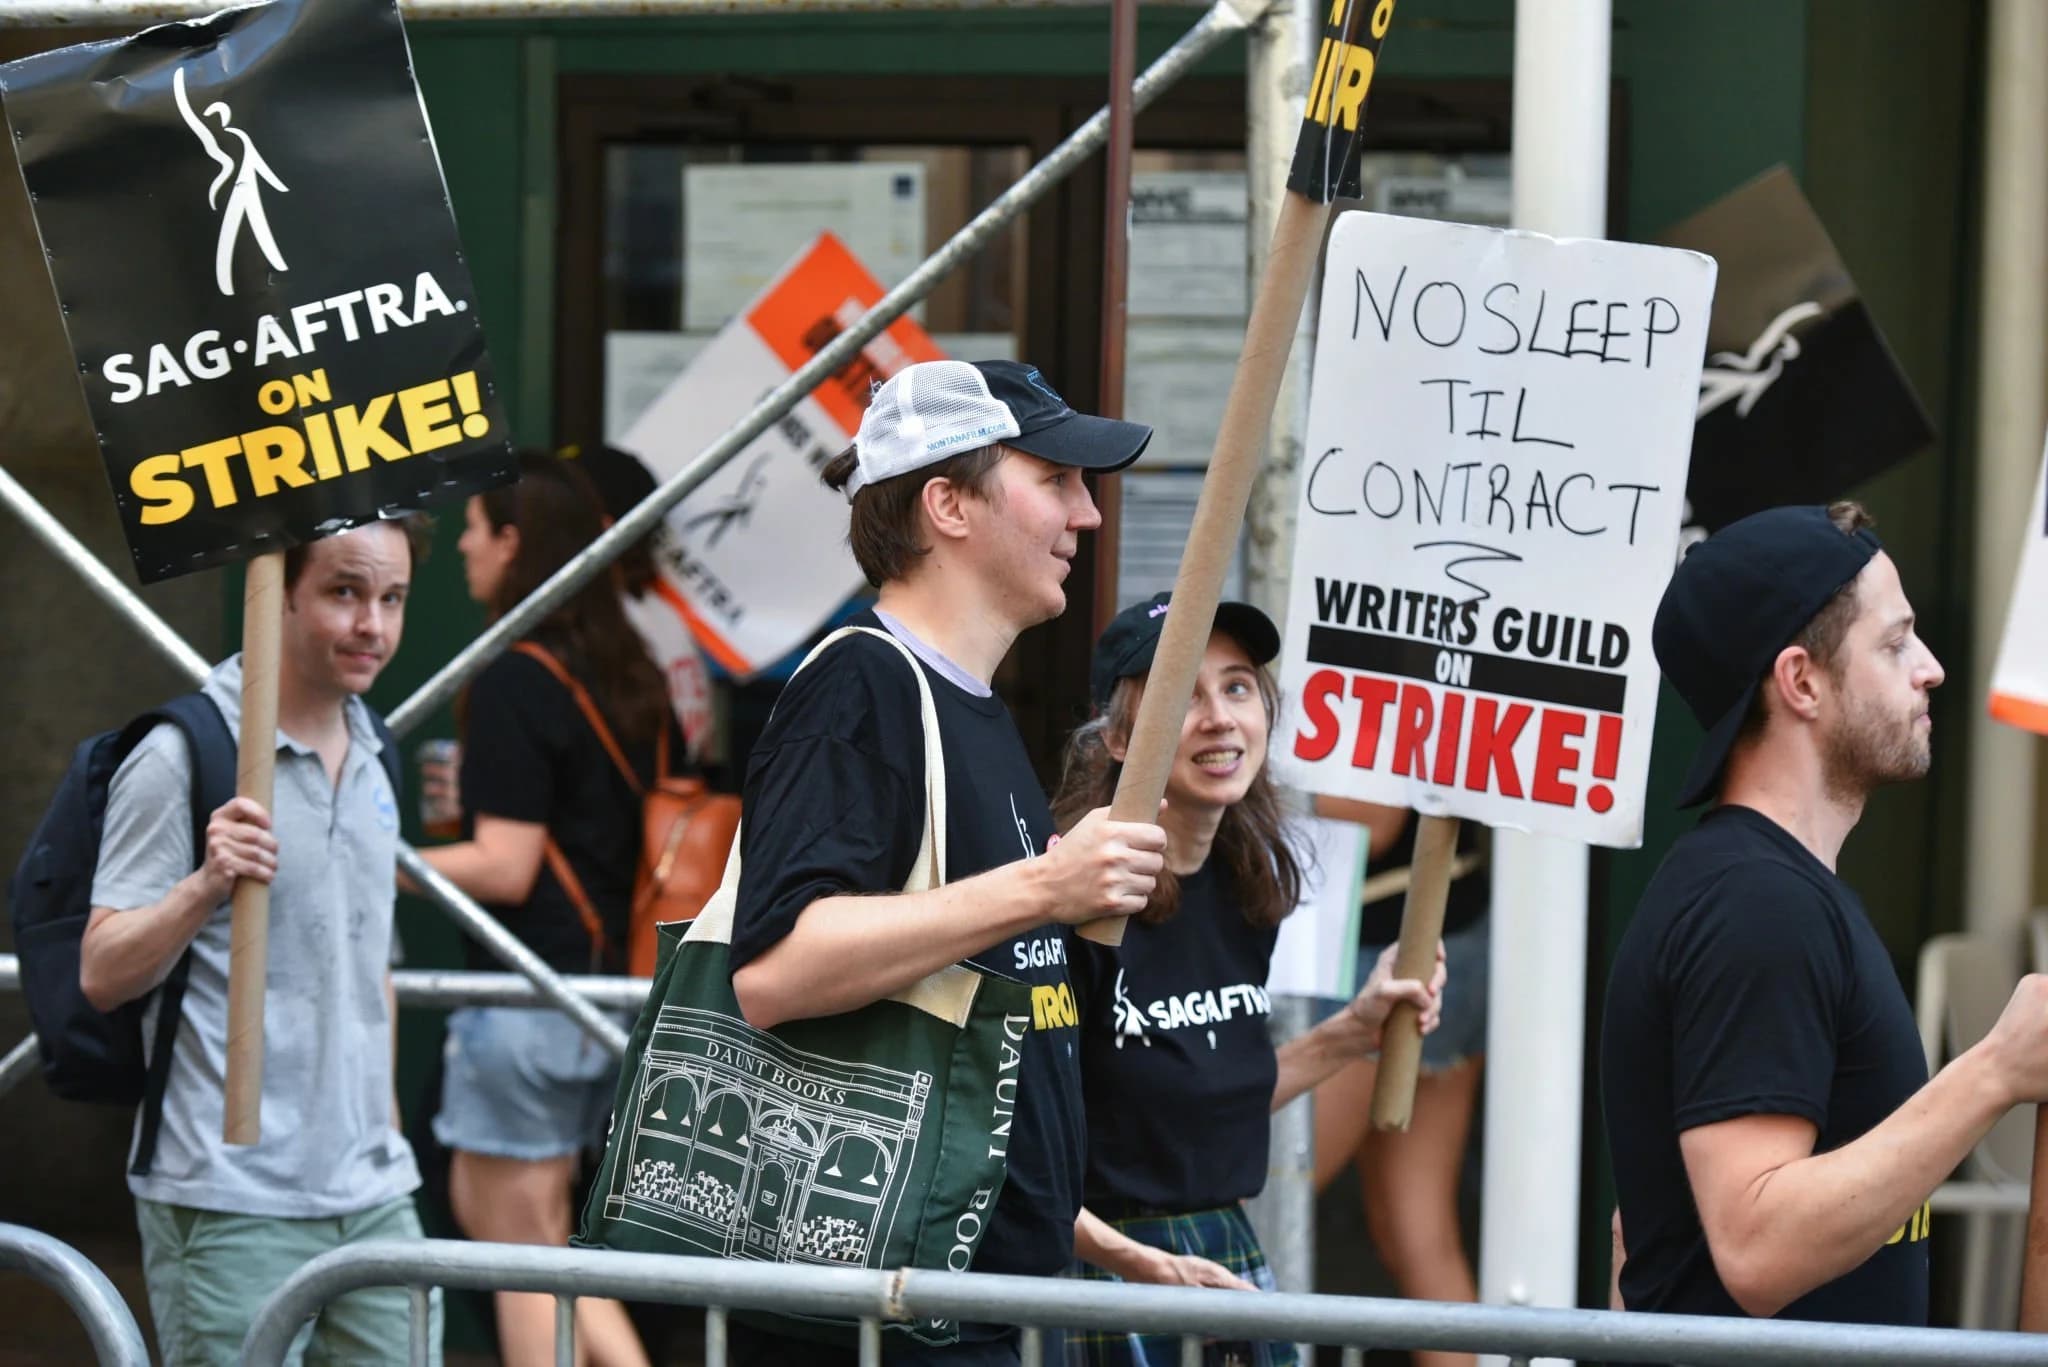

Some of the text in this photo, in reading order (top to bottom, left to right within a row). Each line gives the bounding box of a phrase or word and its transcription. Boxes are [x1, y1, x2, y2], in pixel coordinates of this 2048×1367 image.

[257, 368, 333, 416] ON
[1420, 379, 1575, 448] TIL
[130, 371, 490, 525] STRIKE!
[1307, 448, 1660, 545] CONTRACT
[1314, 576, 1631, 669] WRITERS GUILD
[1435, 650, 1473, 688] ON
[1293, 668, 1624, 815] STRIKE!
[706, 1041, 847, 1105] DAUNT BOOKS
